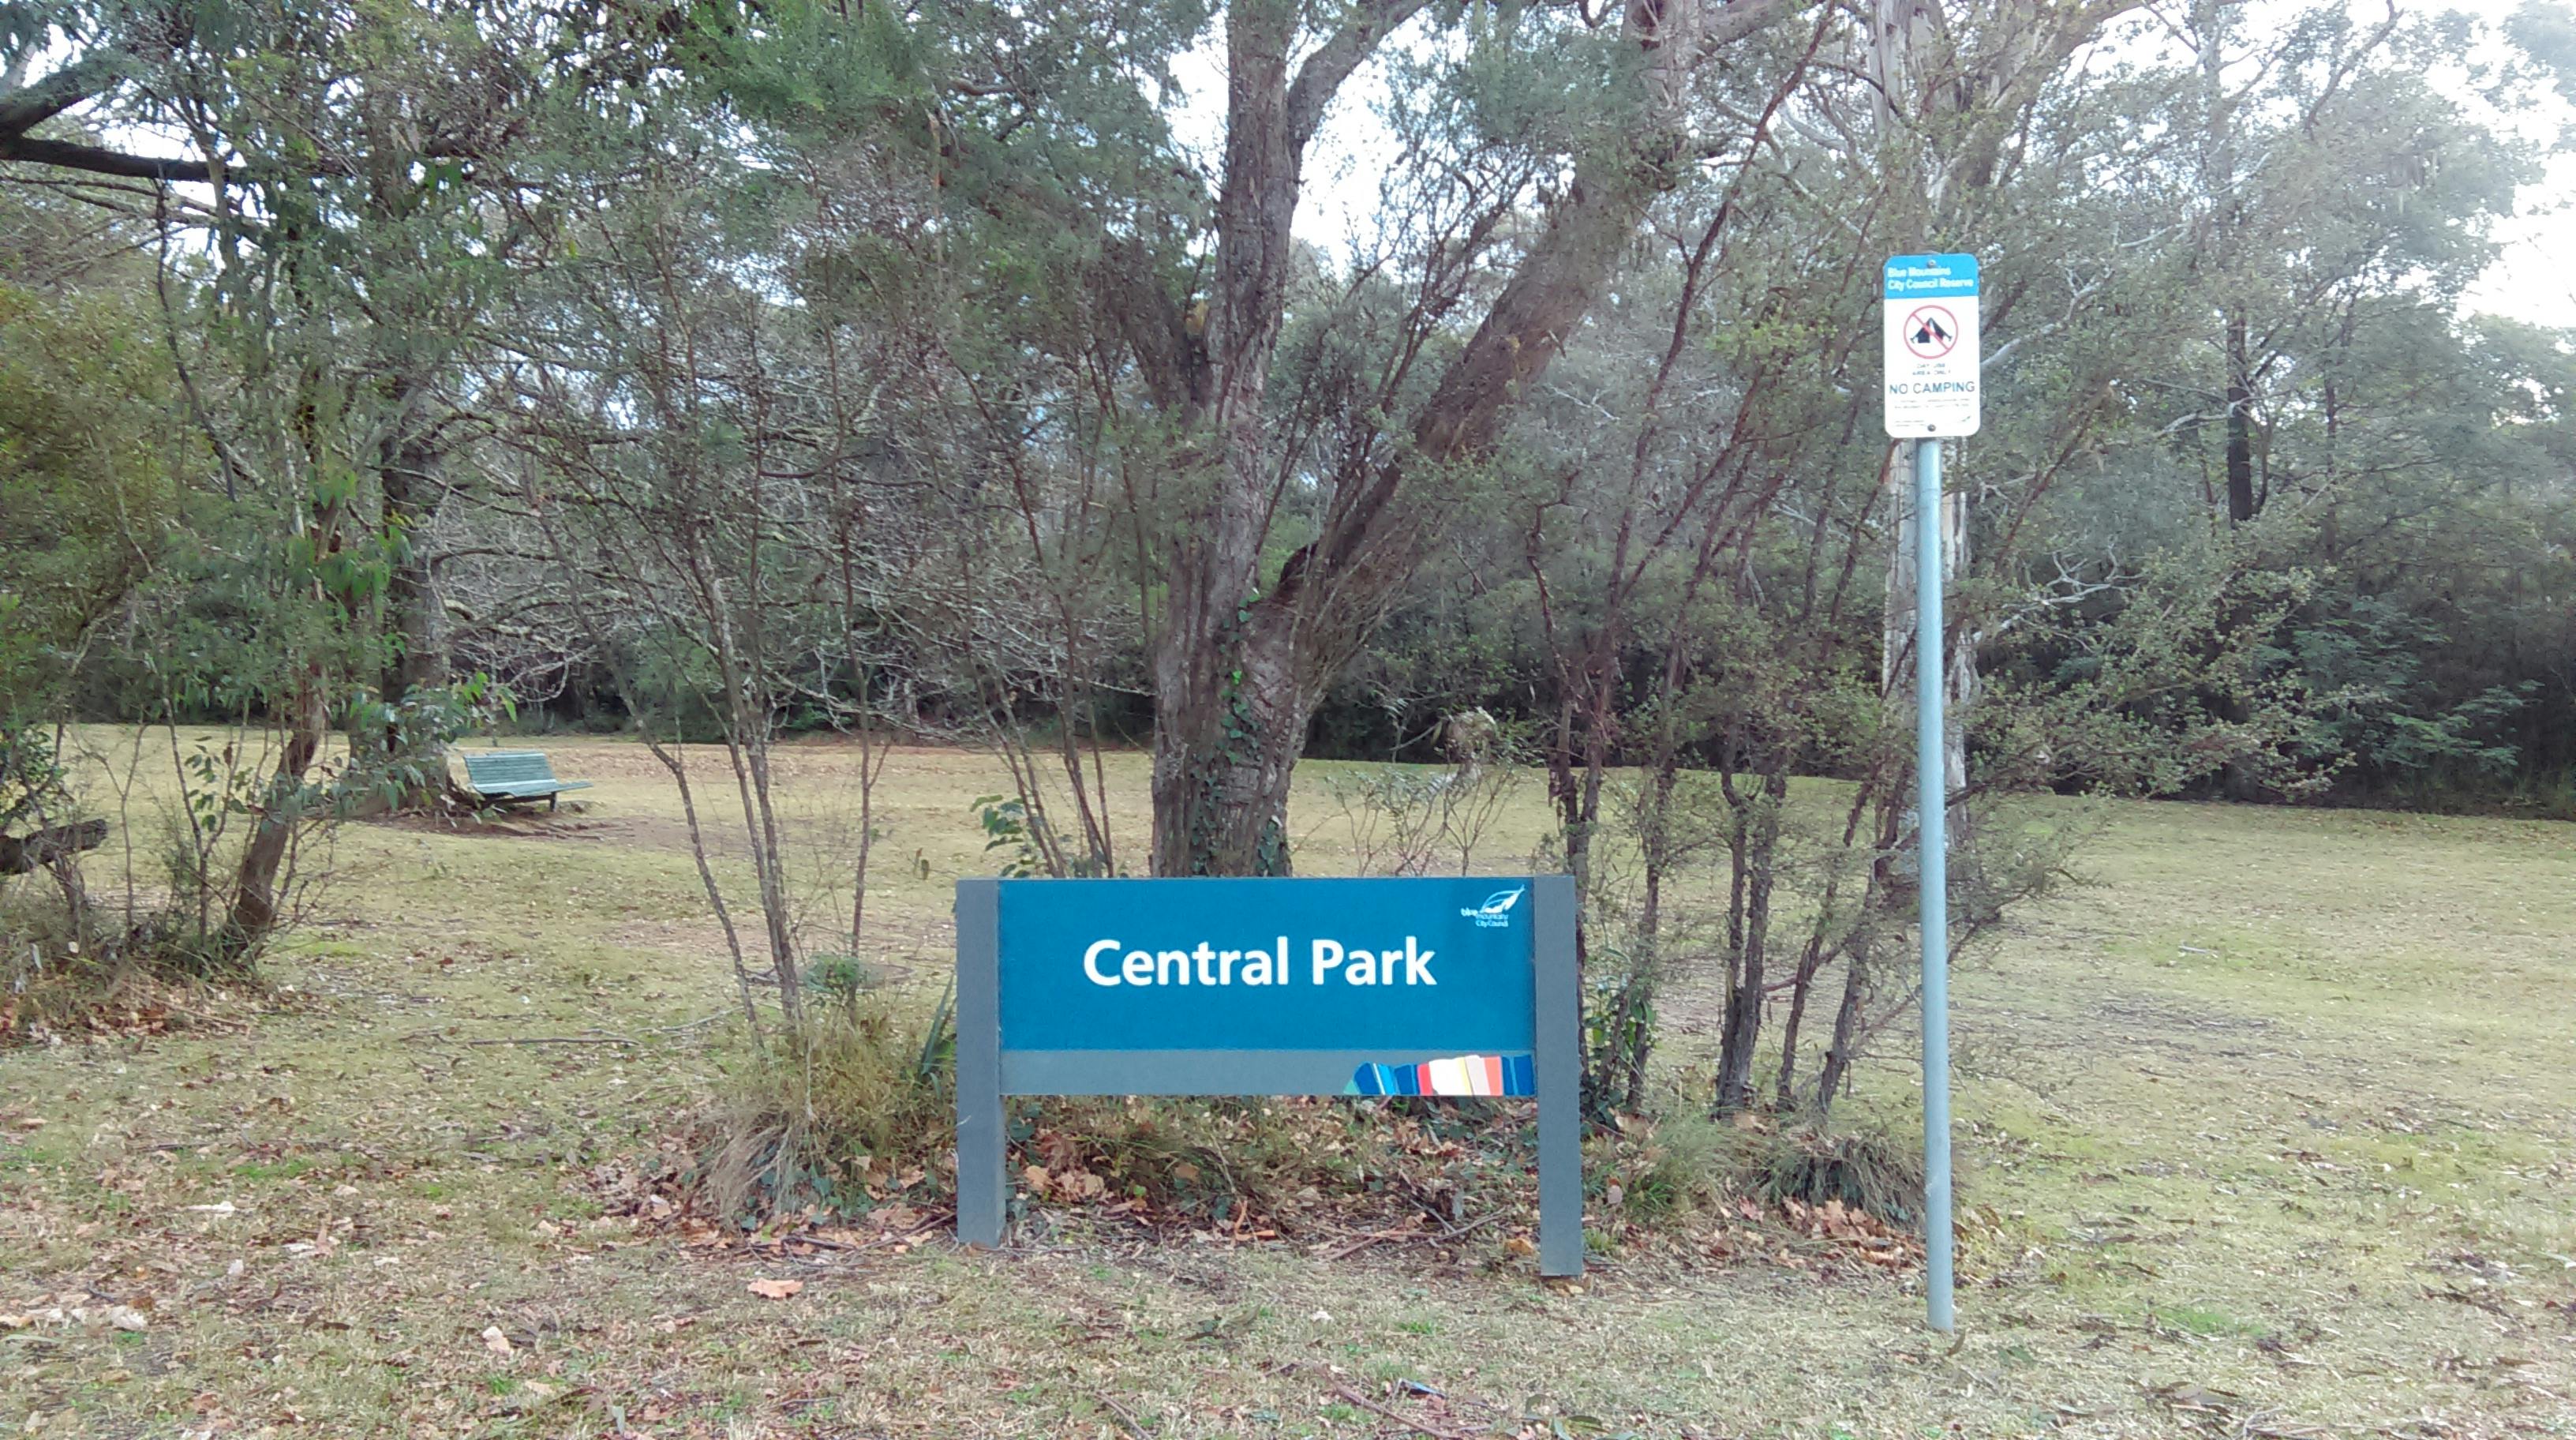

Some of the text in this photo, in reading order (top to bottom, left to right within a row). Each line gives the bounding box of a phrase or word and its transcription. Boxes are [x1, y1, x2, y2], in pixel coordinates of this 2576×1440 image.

[1887, 266, 1951, 278] Blue Mountains
[1887, 278, 1974, 291] City Council Reserve
[1889, 381, 1975, 395] NO CAMPING
[1084, 936, 1436, 986] Central Park
